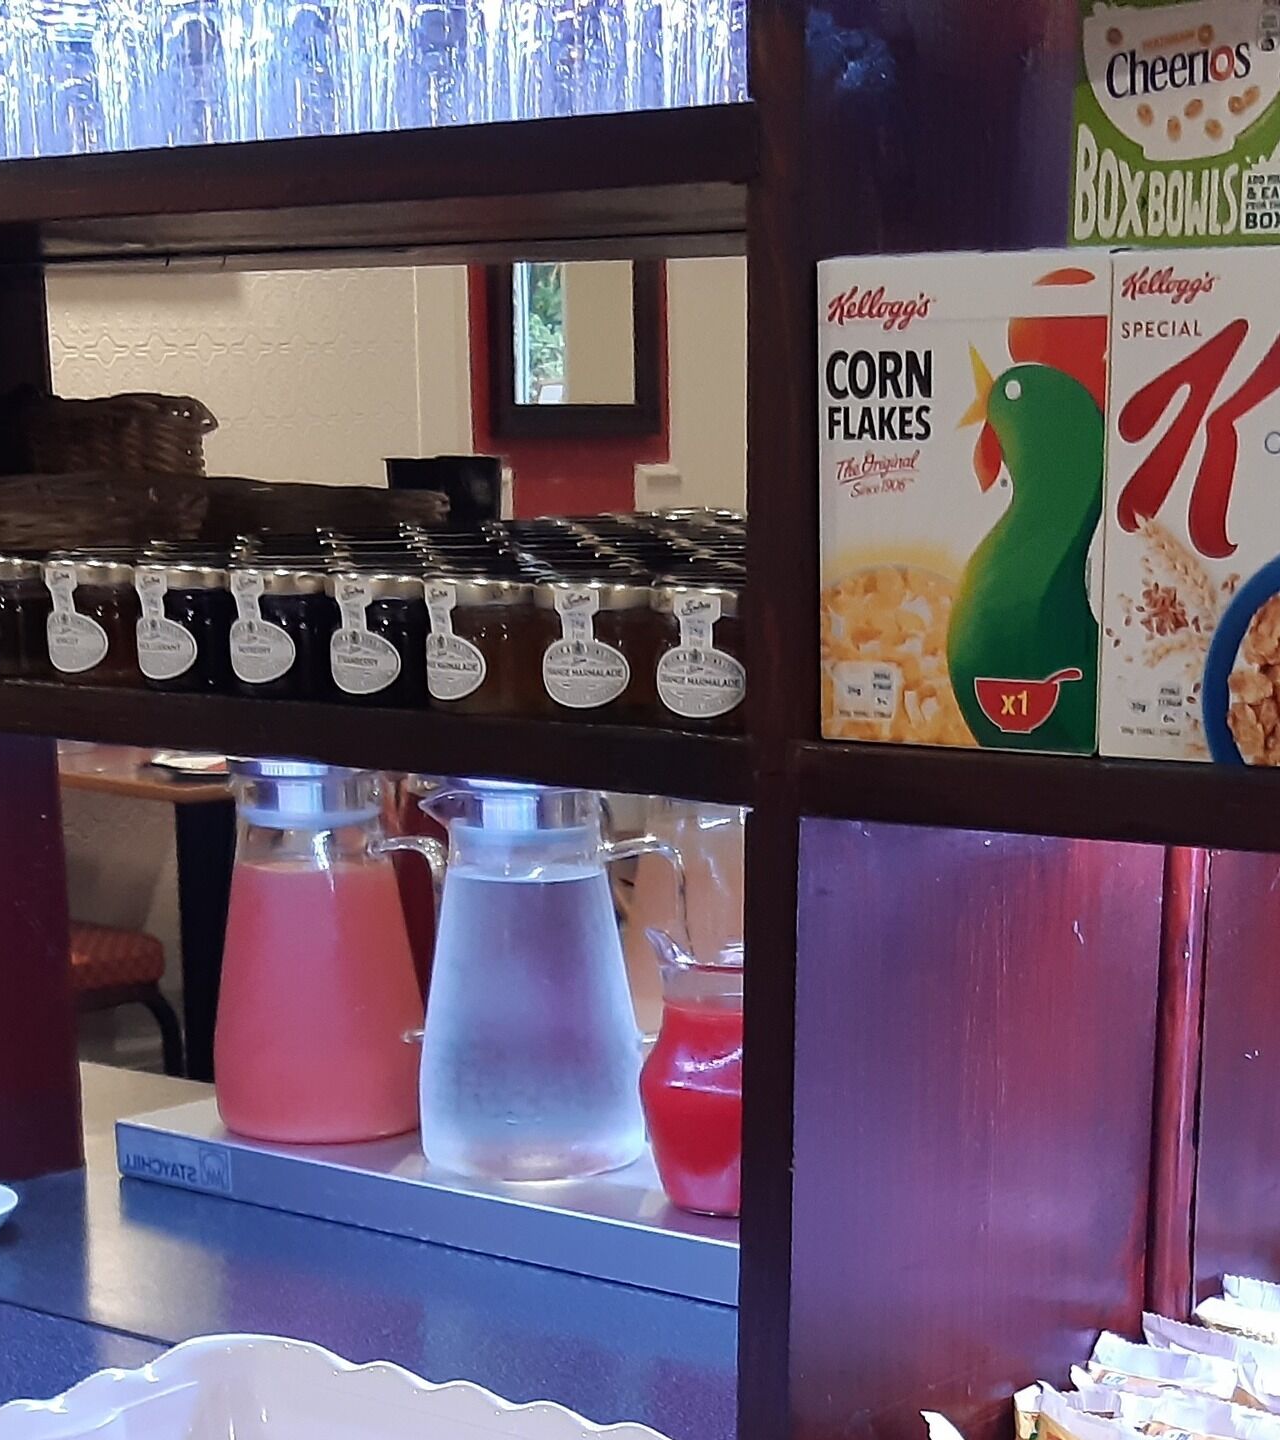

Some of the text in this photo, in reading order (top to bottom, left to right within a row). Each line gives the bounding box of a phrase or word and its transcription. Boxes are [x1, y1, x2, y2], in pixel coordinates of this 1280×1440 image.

[1106, 42, 1252, 98] Cheerios
[1074, 123, 1239, 240] BOX BOWLS
[1121, 266, 1214, 304] Kellogg's
[827, 286, 931, 330] Kellogg's
[1121, 320, 1202, 339] SPECIAL
[826, 350, 932, 399] CORN
[827, 406, 931, 440] FLAKES
[862, 449, 920, 478] Original
[572, 668, 623, 678] MARMALADE
[687, 677, 738, 688] MARMALADE
